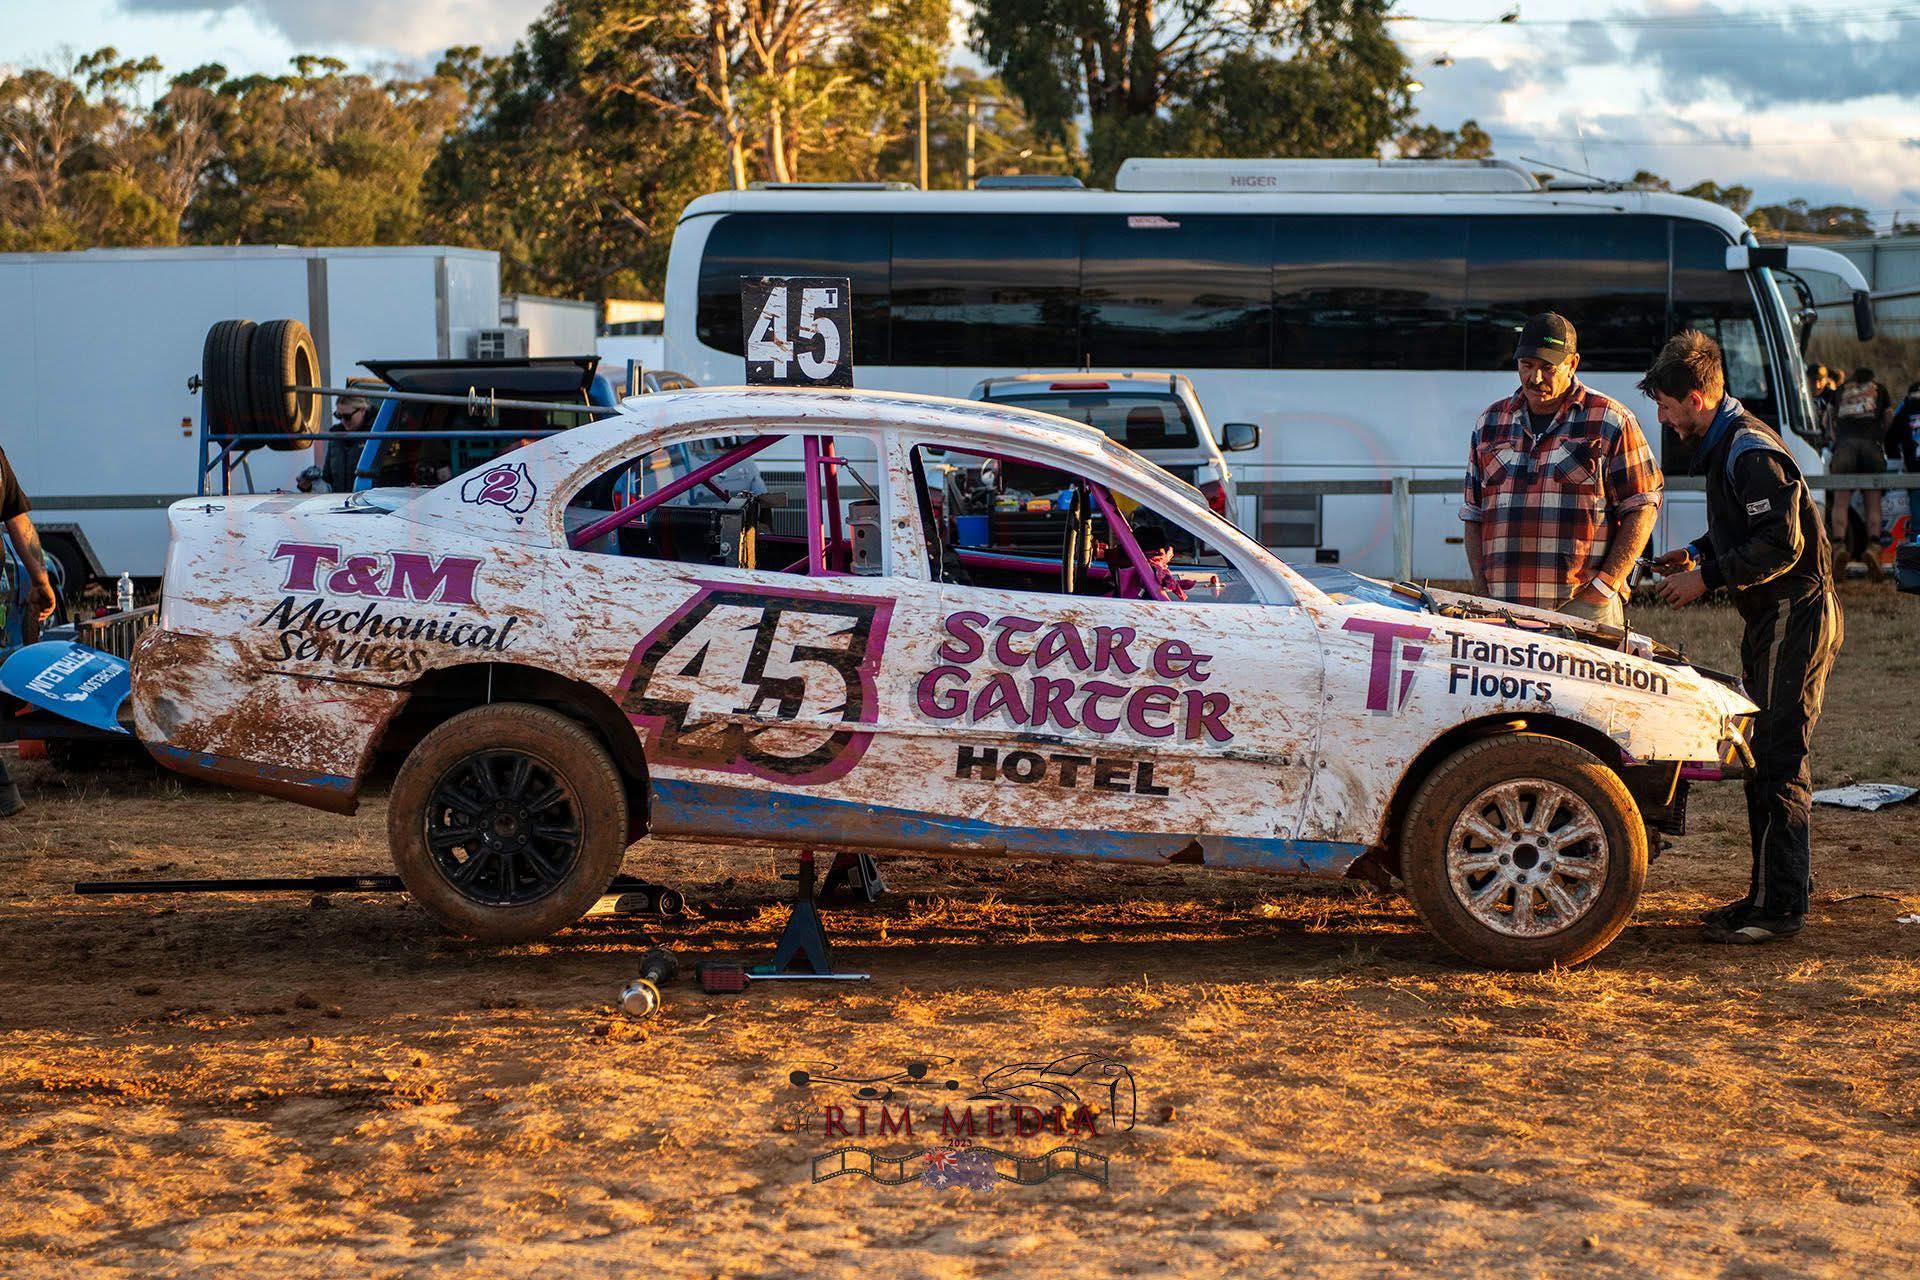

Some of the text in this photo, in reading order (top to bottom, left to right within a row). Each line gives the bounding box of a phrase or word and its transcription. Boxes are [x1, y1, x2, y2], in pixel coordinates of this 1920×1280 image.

[1231, 175, 1277, 187] HIGER
[825, 289, 837, 304] T
[748, 287, 840, 379] 45
[478, 469, 520, 505] 2
[271, 541, 484, 605] T&M
[258, 596, 518, 651] Mechanical
[262, 630, 428, 670] Services
[936, 610, 1214, 682] STAR &
[25, 648, 96, 692] PETROLEUM
[630, 592, 875, 772] 45
[1445, 630, 1670, 696] Transformation
[1448, 664, 1552, 702] Floors
[916, 664, 1235, 742] GARTER
[954, 744, 1171, 797] HOTEL
